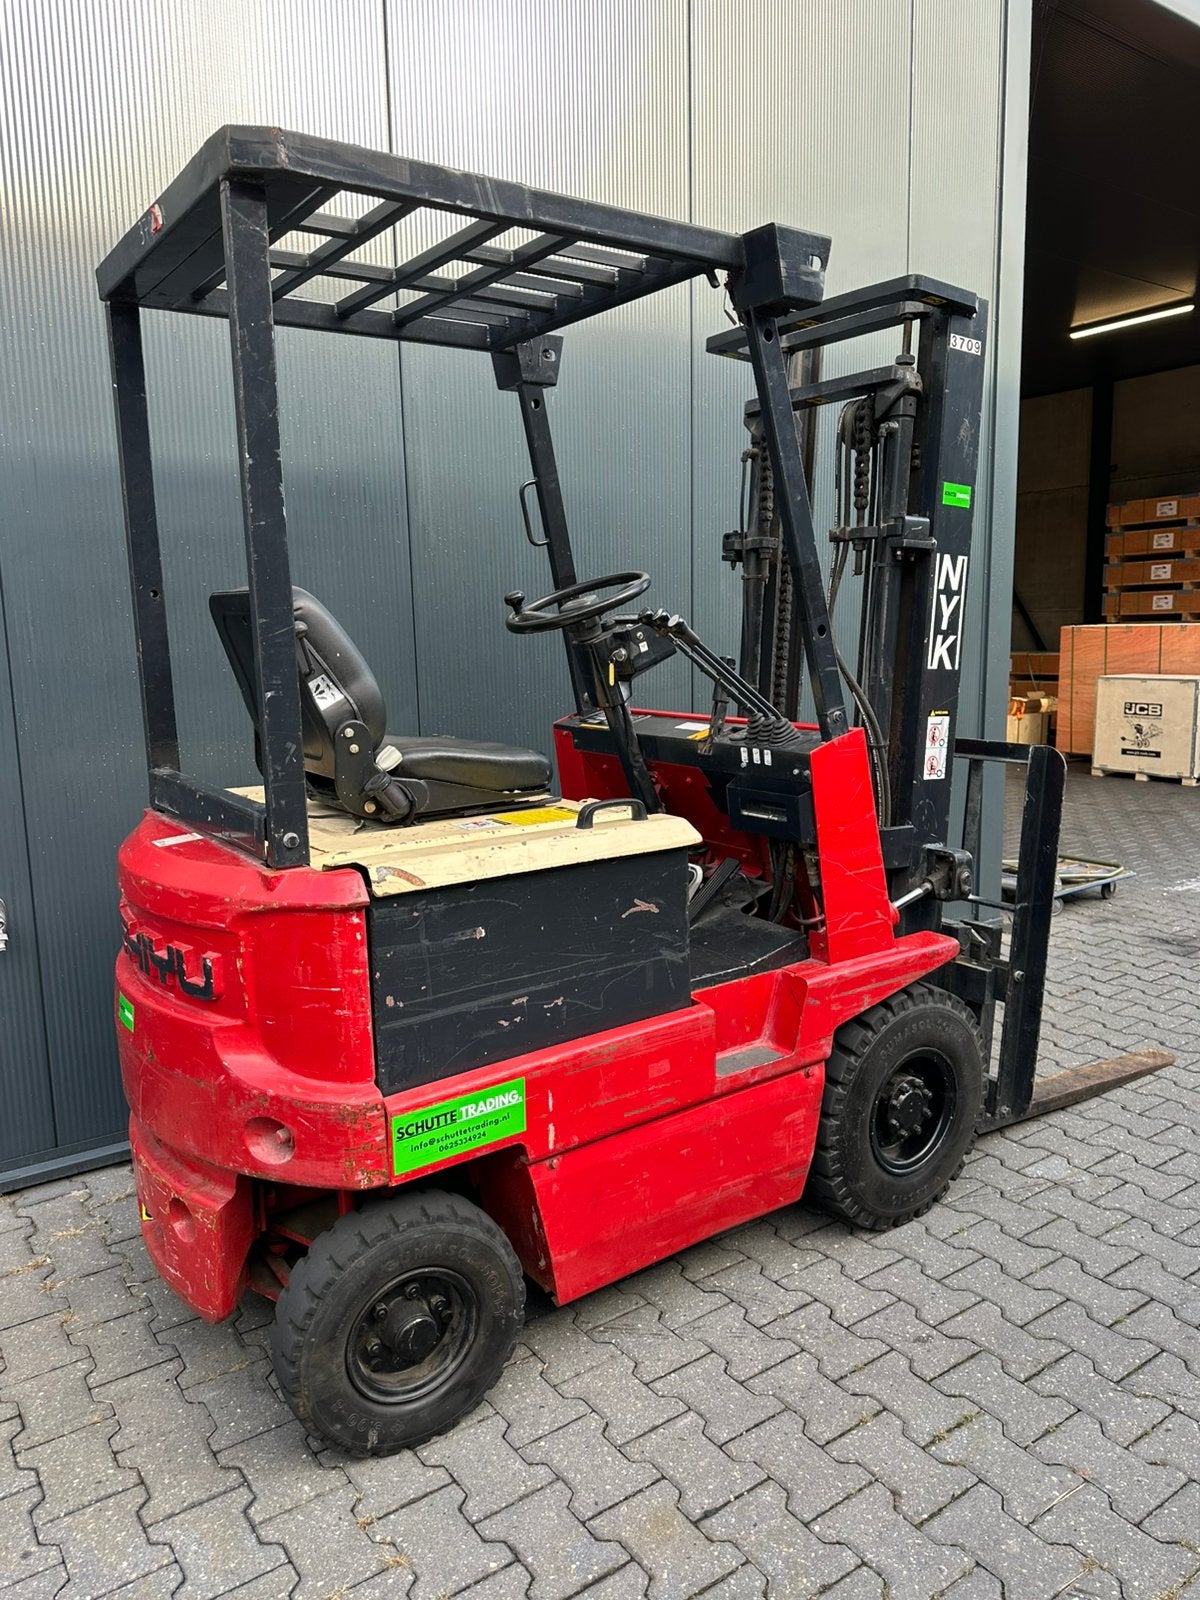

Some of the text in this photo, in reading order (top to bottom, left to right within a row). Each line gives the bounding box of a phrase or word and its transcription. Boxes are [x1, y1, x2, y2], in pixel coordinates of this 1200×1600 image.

[951, 335, 980, 353] 3709
[931, 553, 965, 670] NYK
[1125, 703, 1161, 715] JCB
[396, 1089, 522, 1141] SCHUTTE TRADING.
[410, 1112, 510, 1152] info@schuttetrading.nl
[438, 1131, 487, 1152] 0625334924
